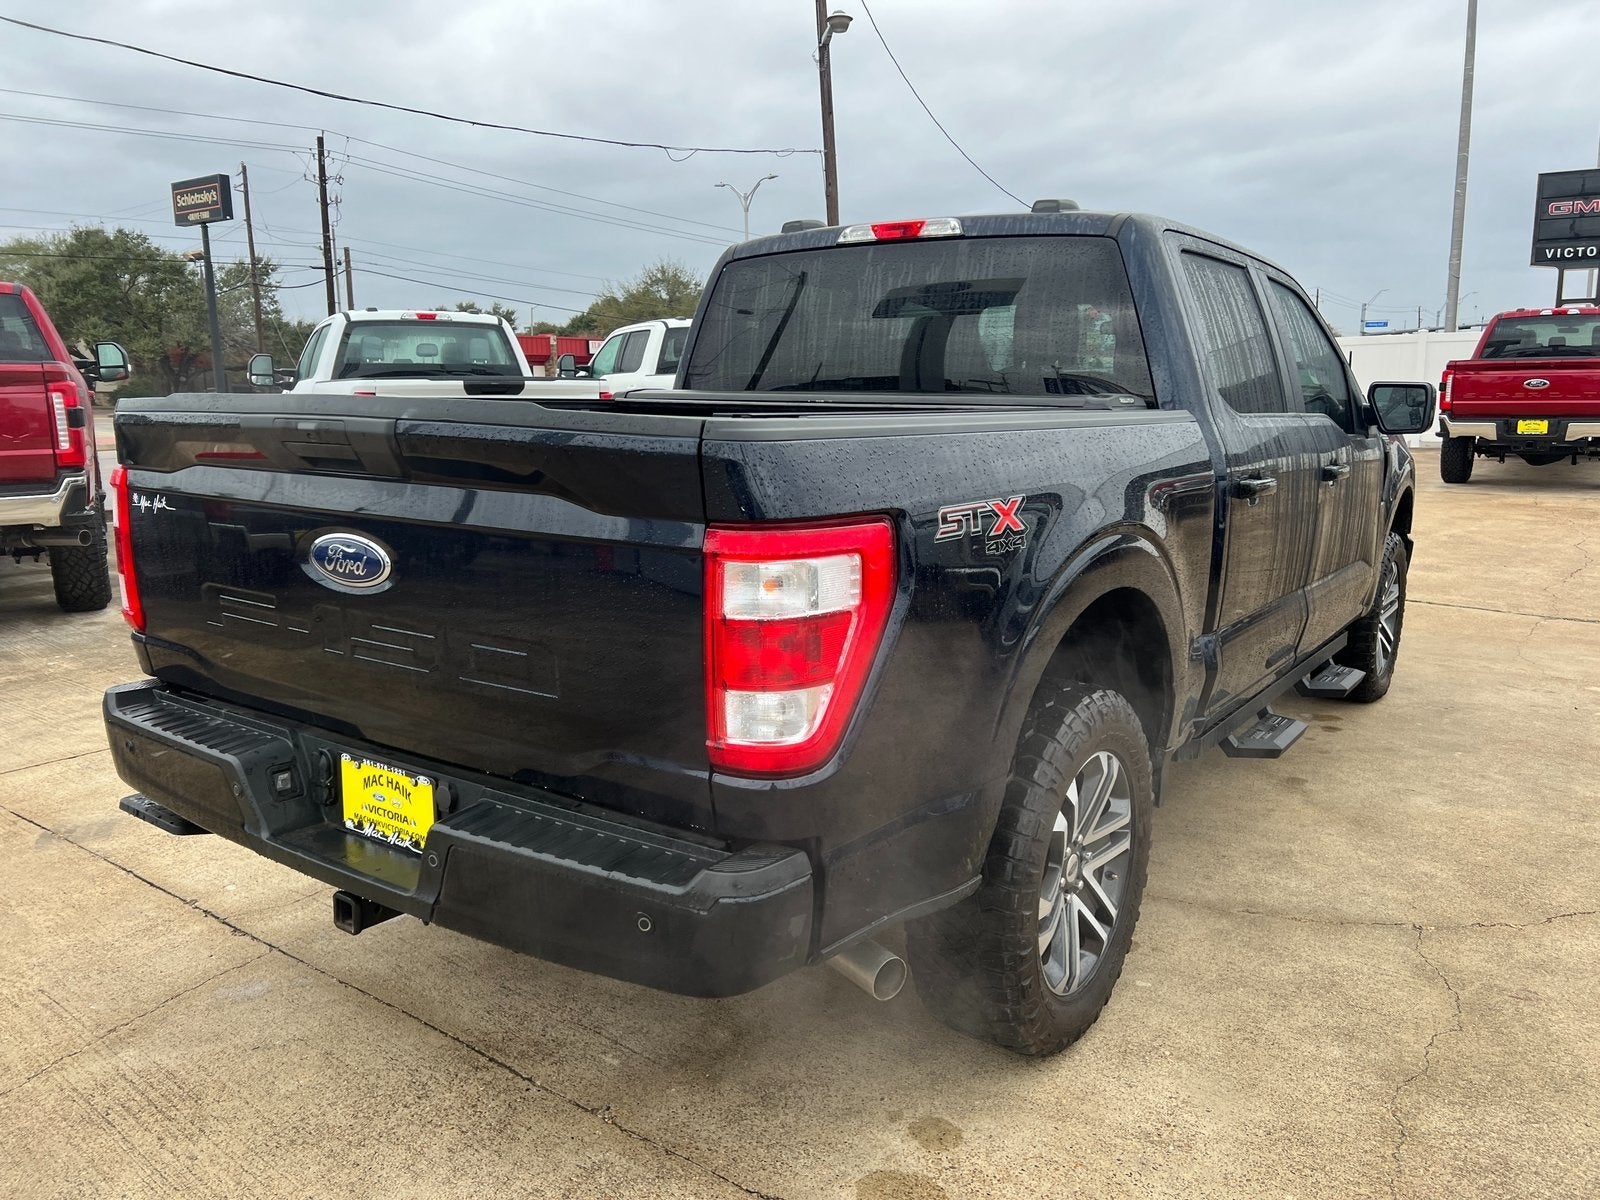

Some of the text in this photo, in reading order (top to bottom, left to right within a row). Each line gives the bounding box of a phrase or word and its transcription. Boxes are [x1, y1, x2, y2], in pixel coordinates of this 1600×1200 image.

[176, 189, 218, 207] Schlotzsky's
[1545, 246, 1597, 259] VICTO
[934, 493, 1030, 544] STX
[324, 543, 367, 576] Ford
[363, 774, 385, 791] MAC
[386, 775, 412, 807] HAIK
[367, 803, 410, 827] VICTORIA
[360, 821, 423, 854] Mac Haik
